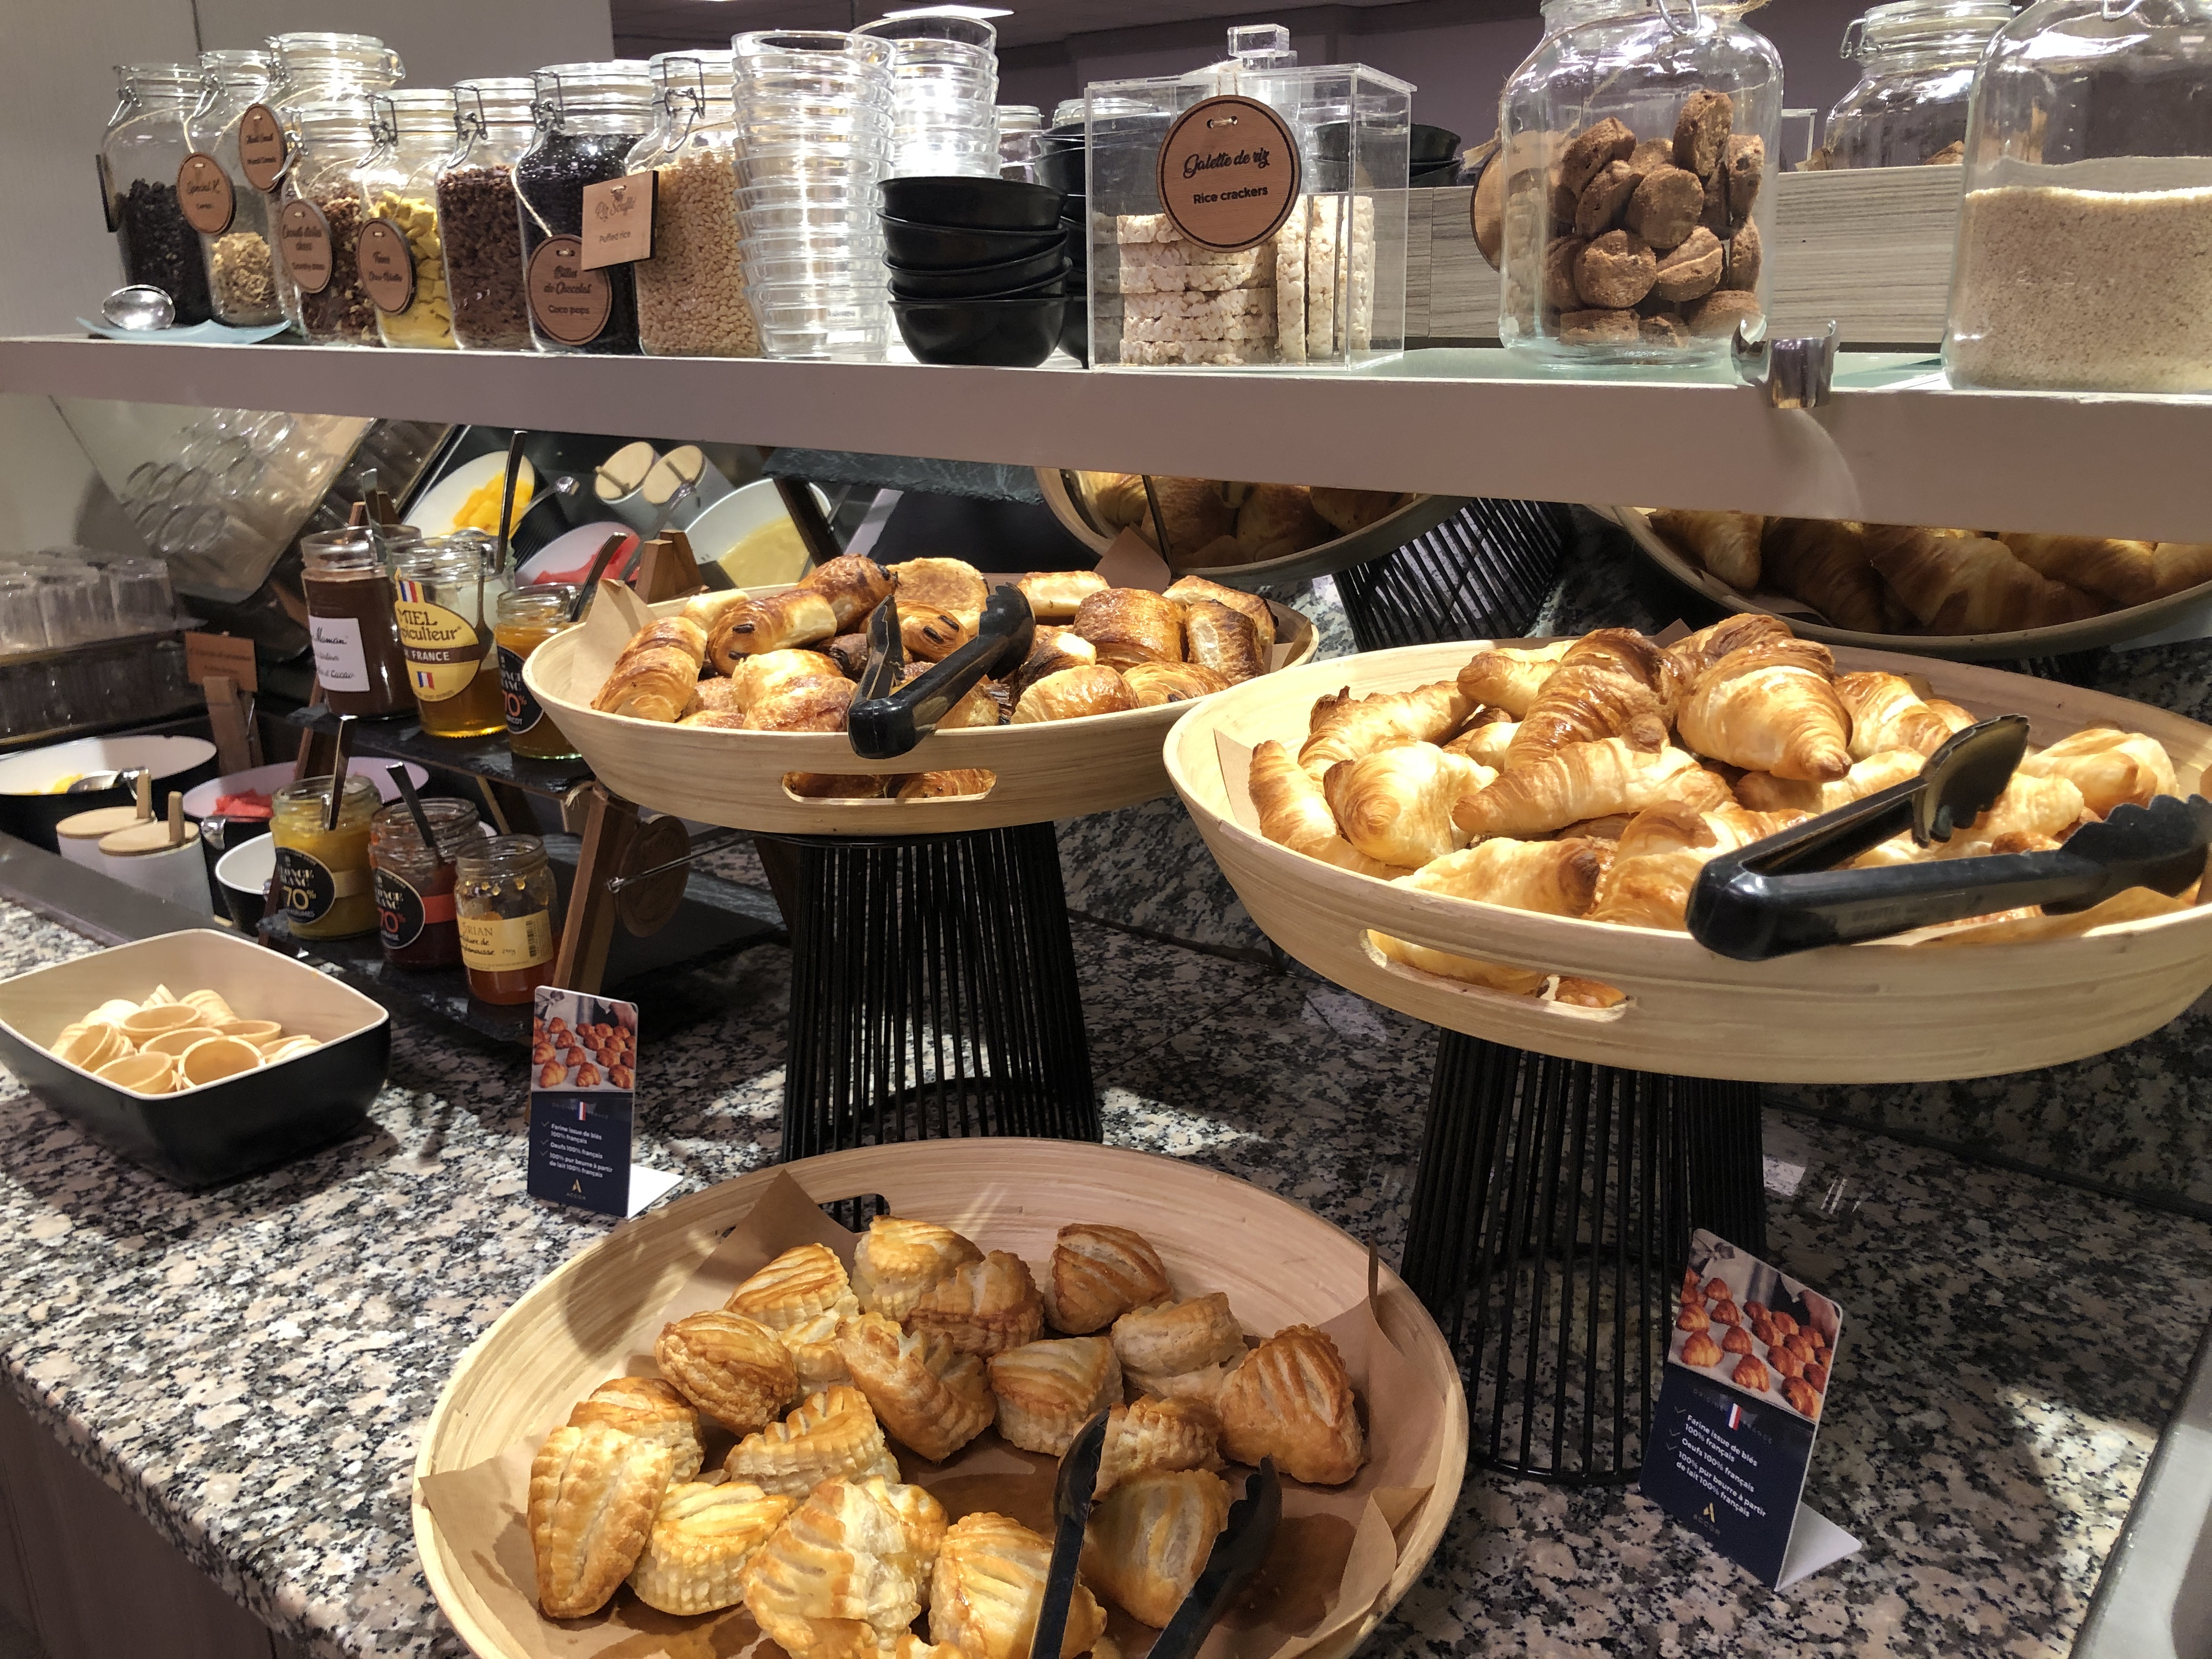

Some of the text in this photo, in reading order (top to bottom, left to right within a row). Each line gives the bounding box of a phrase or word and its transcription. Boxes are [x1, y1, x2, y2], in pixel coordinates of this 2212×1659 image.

[1183, 147, 1271, 179] Galette de riz
[1193, 185, 1268, 204] Rice crackers
[599, 231, 631, 244] Puffed rice
[549, 305, 590, 315] Coco pops
[411, 650, 450, 661] FRANCE
[282, 885, 317, 910] 70%
[551, 1123, 568, 1132] Farine
[569, 1126, 582, 1135] issue
[591, 1132, 602, 1141] blés
[551, 1130, 588, 1144] 100% français
[550, 1142, 603, 1159] Oeufs 100% français
[550, 1152, 565, 1161] 100%
[575, 1158, 592, 1167] beurre
[597, 1165, 613, 1173] partir
[567, 1164, 582, 1172] 100%
[582, 1167, 603, 1178] français
[1685, 1423, 1735, 1462] 100% français
[1688, 1414, 1758, 1466] Farine issue de blés
[1682, 1438, 1754, 1493] Oeufs 100% français
[1676, 1462, 1750, 1517] de lait 100% français
[1679, 1451, 1766, 1517] 100% pur beurre à partir
